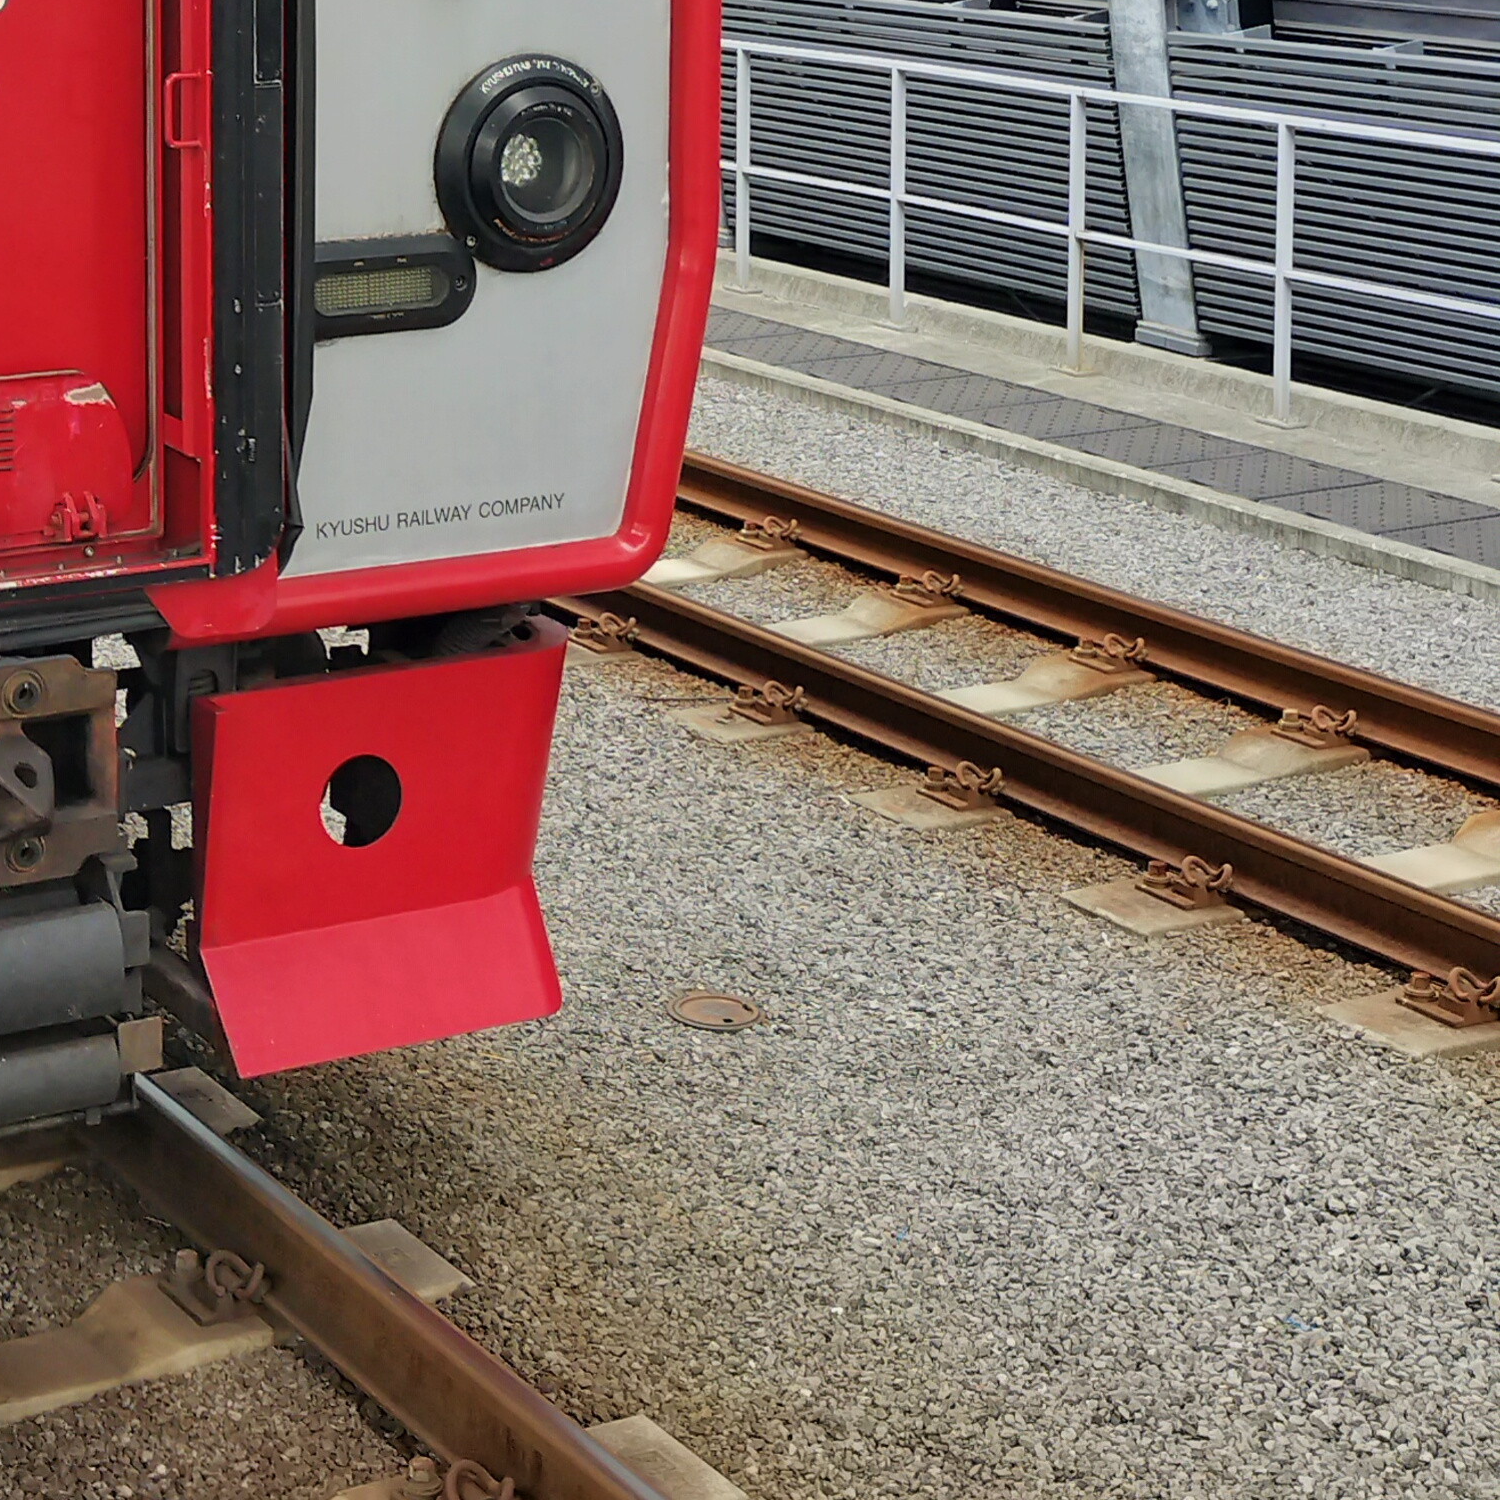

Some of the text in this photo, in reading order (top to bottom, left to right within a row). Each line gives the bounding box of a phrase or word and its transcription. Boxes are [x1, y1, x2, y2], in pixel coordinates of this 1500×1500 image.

[316, 492, 566, 540] KYUSHU RAILWAY COMPANY
